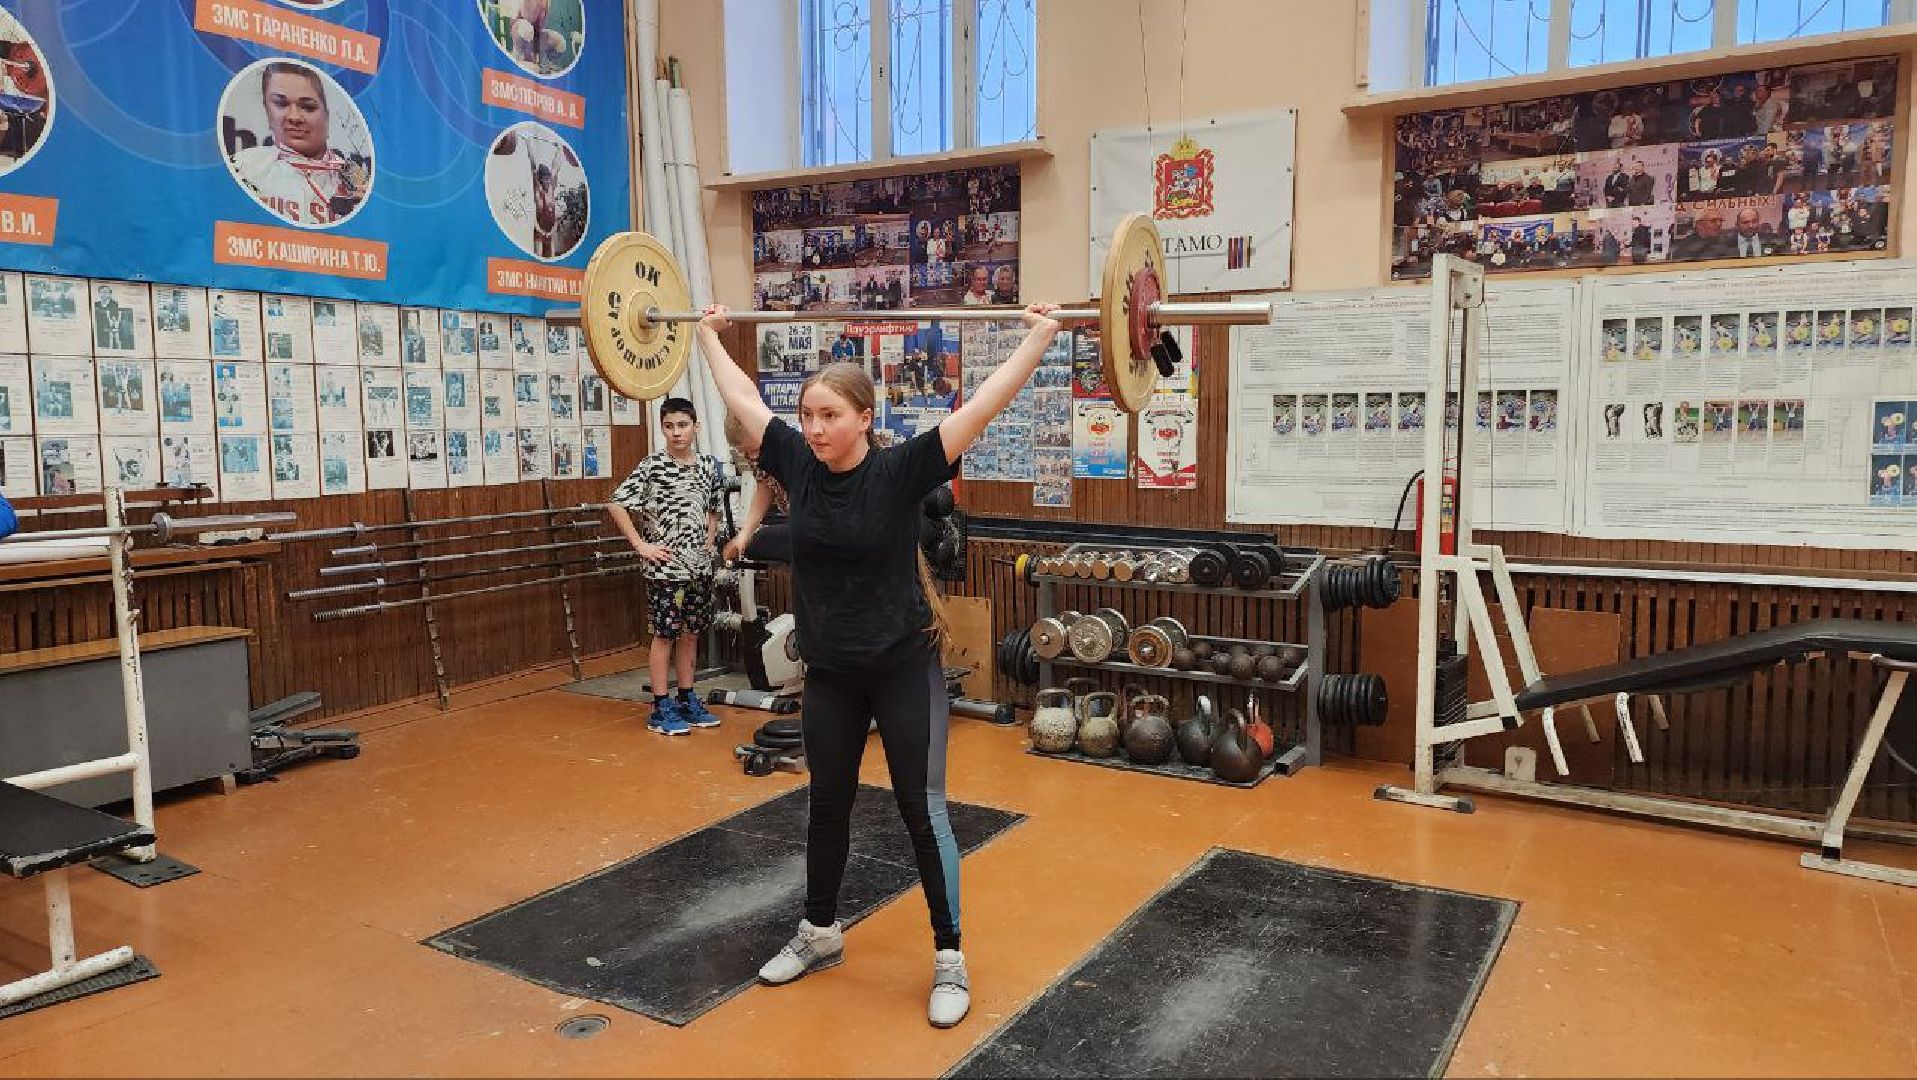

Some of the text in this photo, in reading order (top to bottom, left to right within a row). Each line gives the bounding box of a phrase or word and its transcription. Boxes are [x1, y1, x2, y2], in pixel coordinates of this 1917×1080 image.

[211, 3, 249, 32] ЗМС
[253, 12, 336, 56] ТАРАНЕНКО
[518, 88, 555, 113] ПЕТРОВ
[1, 210, 42, 236] В.И.
[227, 235, 381, 273] ЗМС КАШИРИНА Т.Ю.
[497, 270, 523, 288] ЗМС
[788, 336, 812, 350] МАЯ
